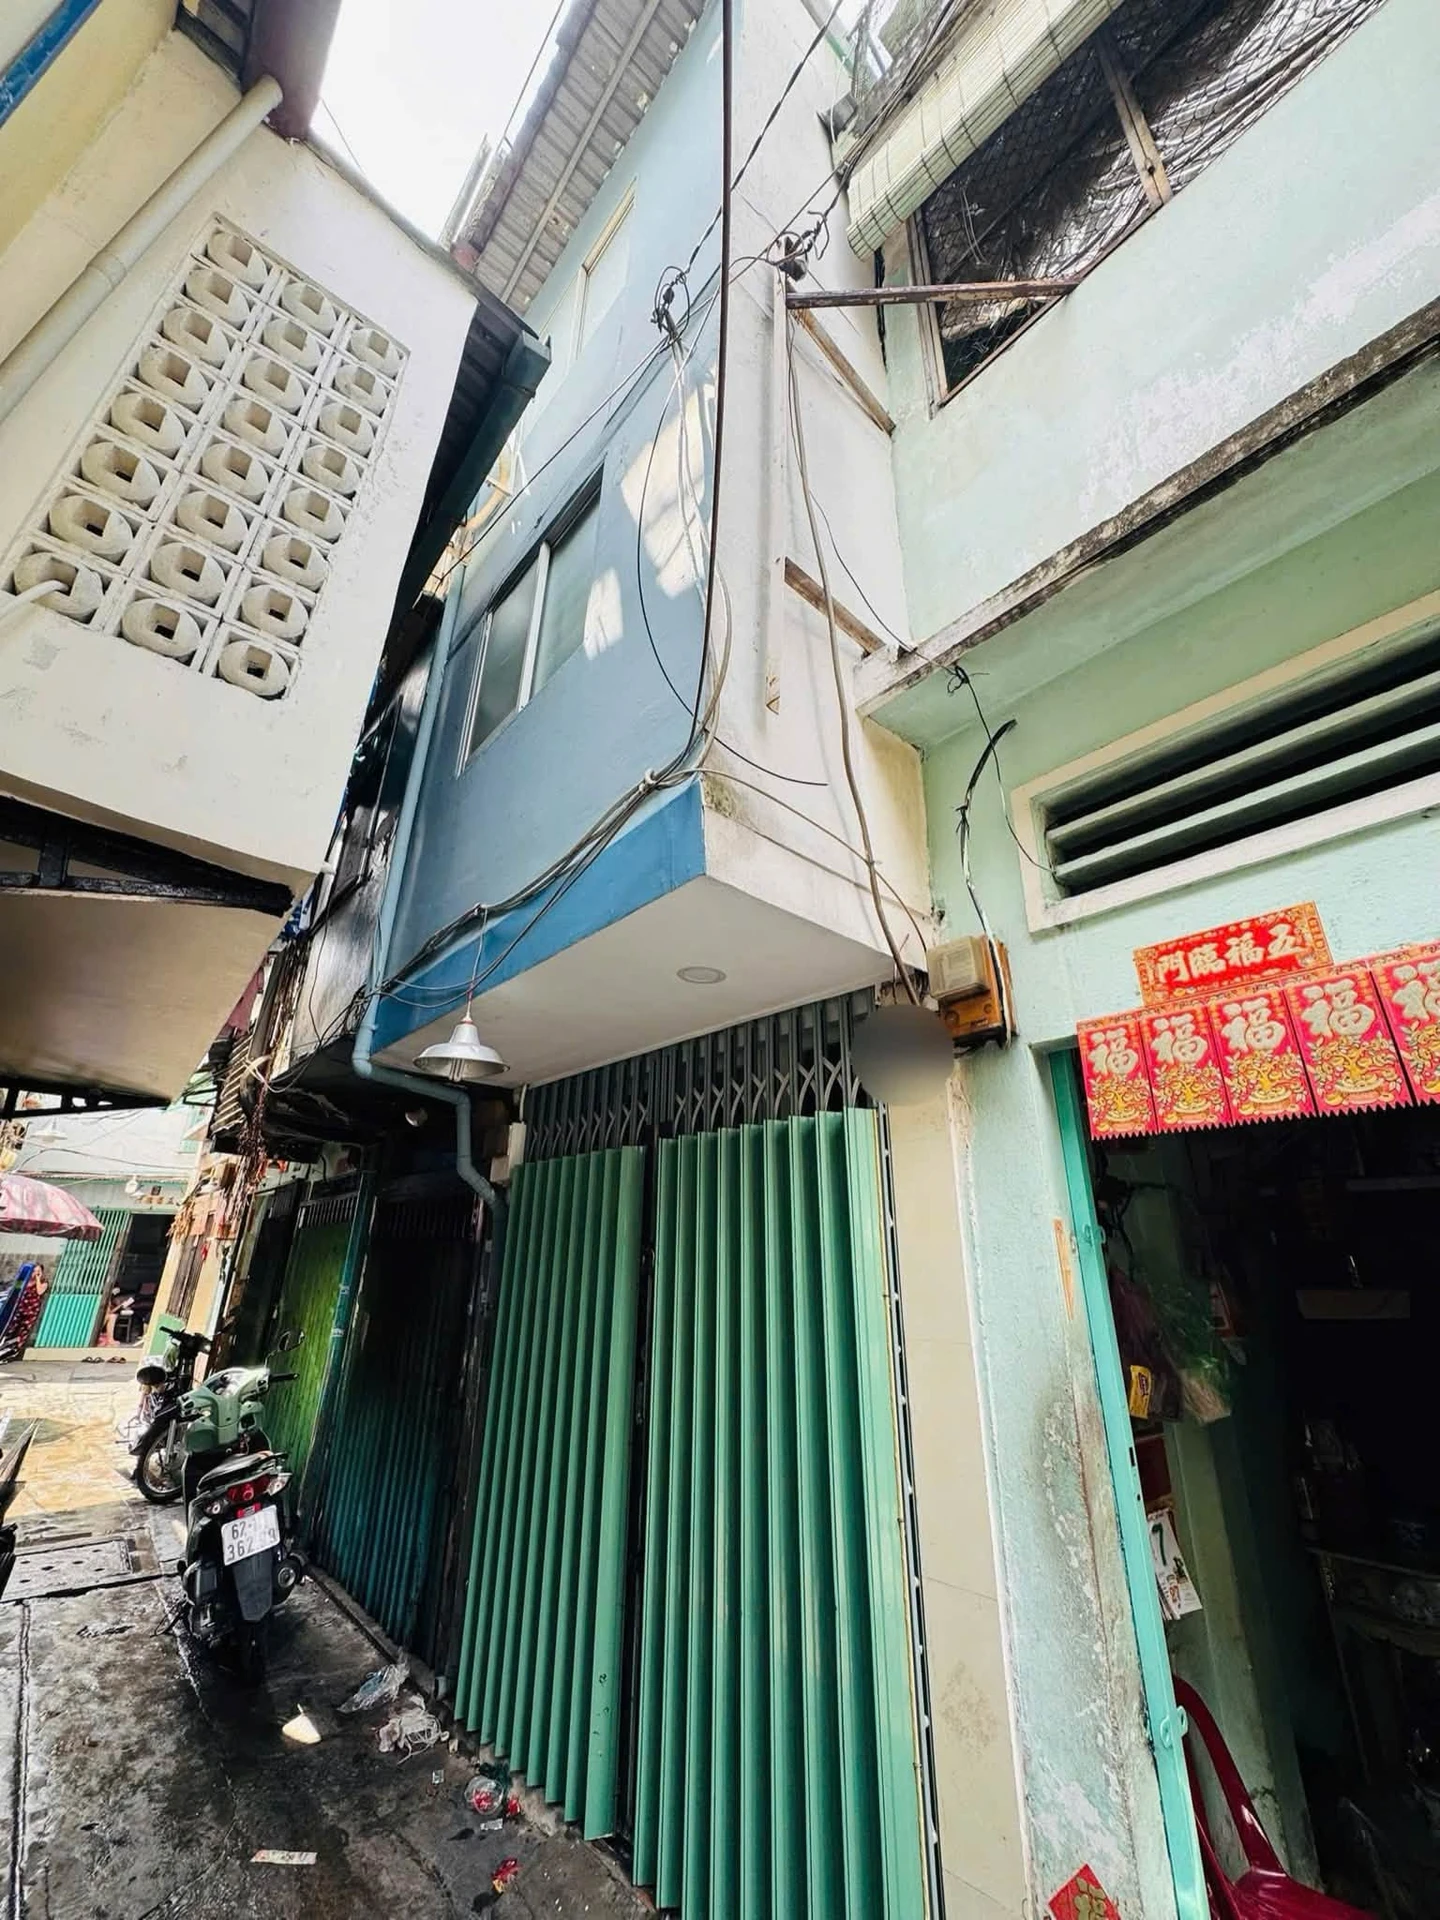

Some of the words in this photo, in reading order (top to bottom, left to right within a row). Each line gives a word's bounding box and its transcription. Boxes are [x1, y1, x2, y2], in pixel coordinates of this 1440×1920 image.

[1088, 1027, 1139, 1076] 福
[1151, 1013, 1208, 1065] 福
[1221, 997, 1286, 1052] 福
[1301, 978, 1375, 1039] 福
